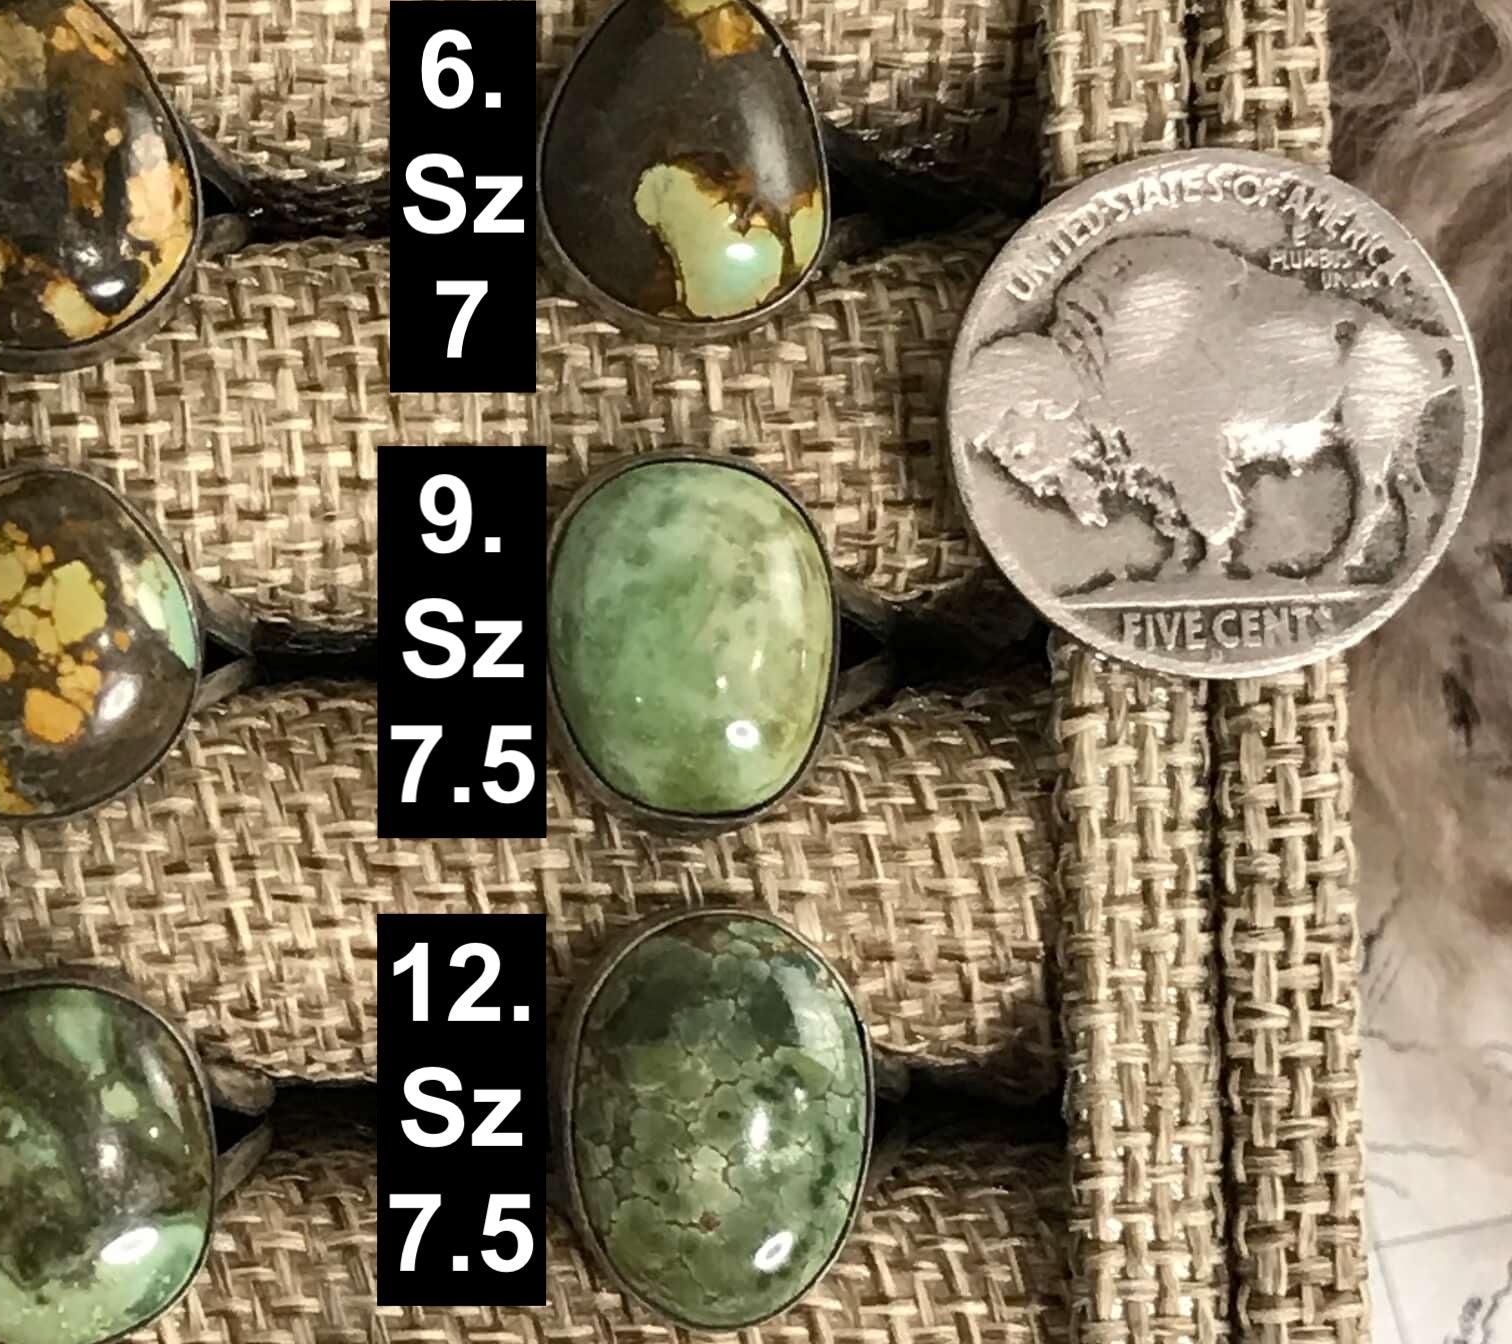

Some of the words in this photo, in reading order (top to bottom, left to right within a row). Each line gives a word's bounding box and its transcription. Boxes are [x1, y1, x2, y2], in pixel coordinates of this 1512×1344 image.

[1005, 203, 1106, 302] UNITED
[1107, 168, 1225, 222] STATES
[1121, 608, 1207, 652] FIVE
[1211, 603, 1334, 649] CENTS
